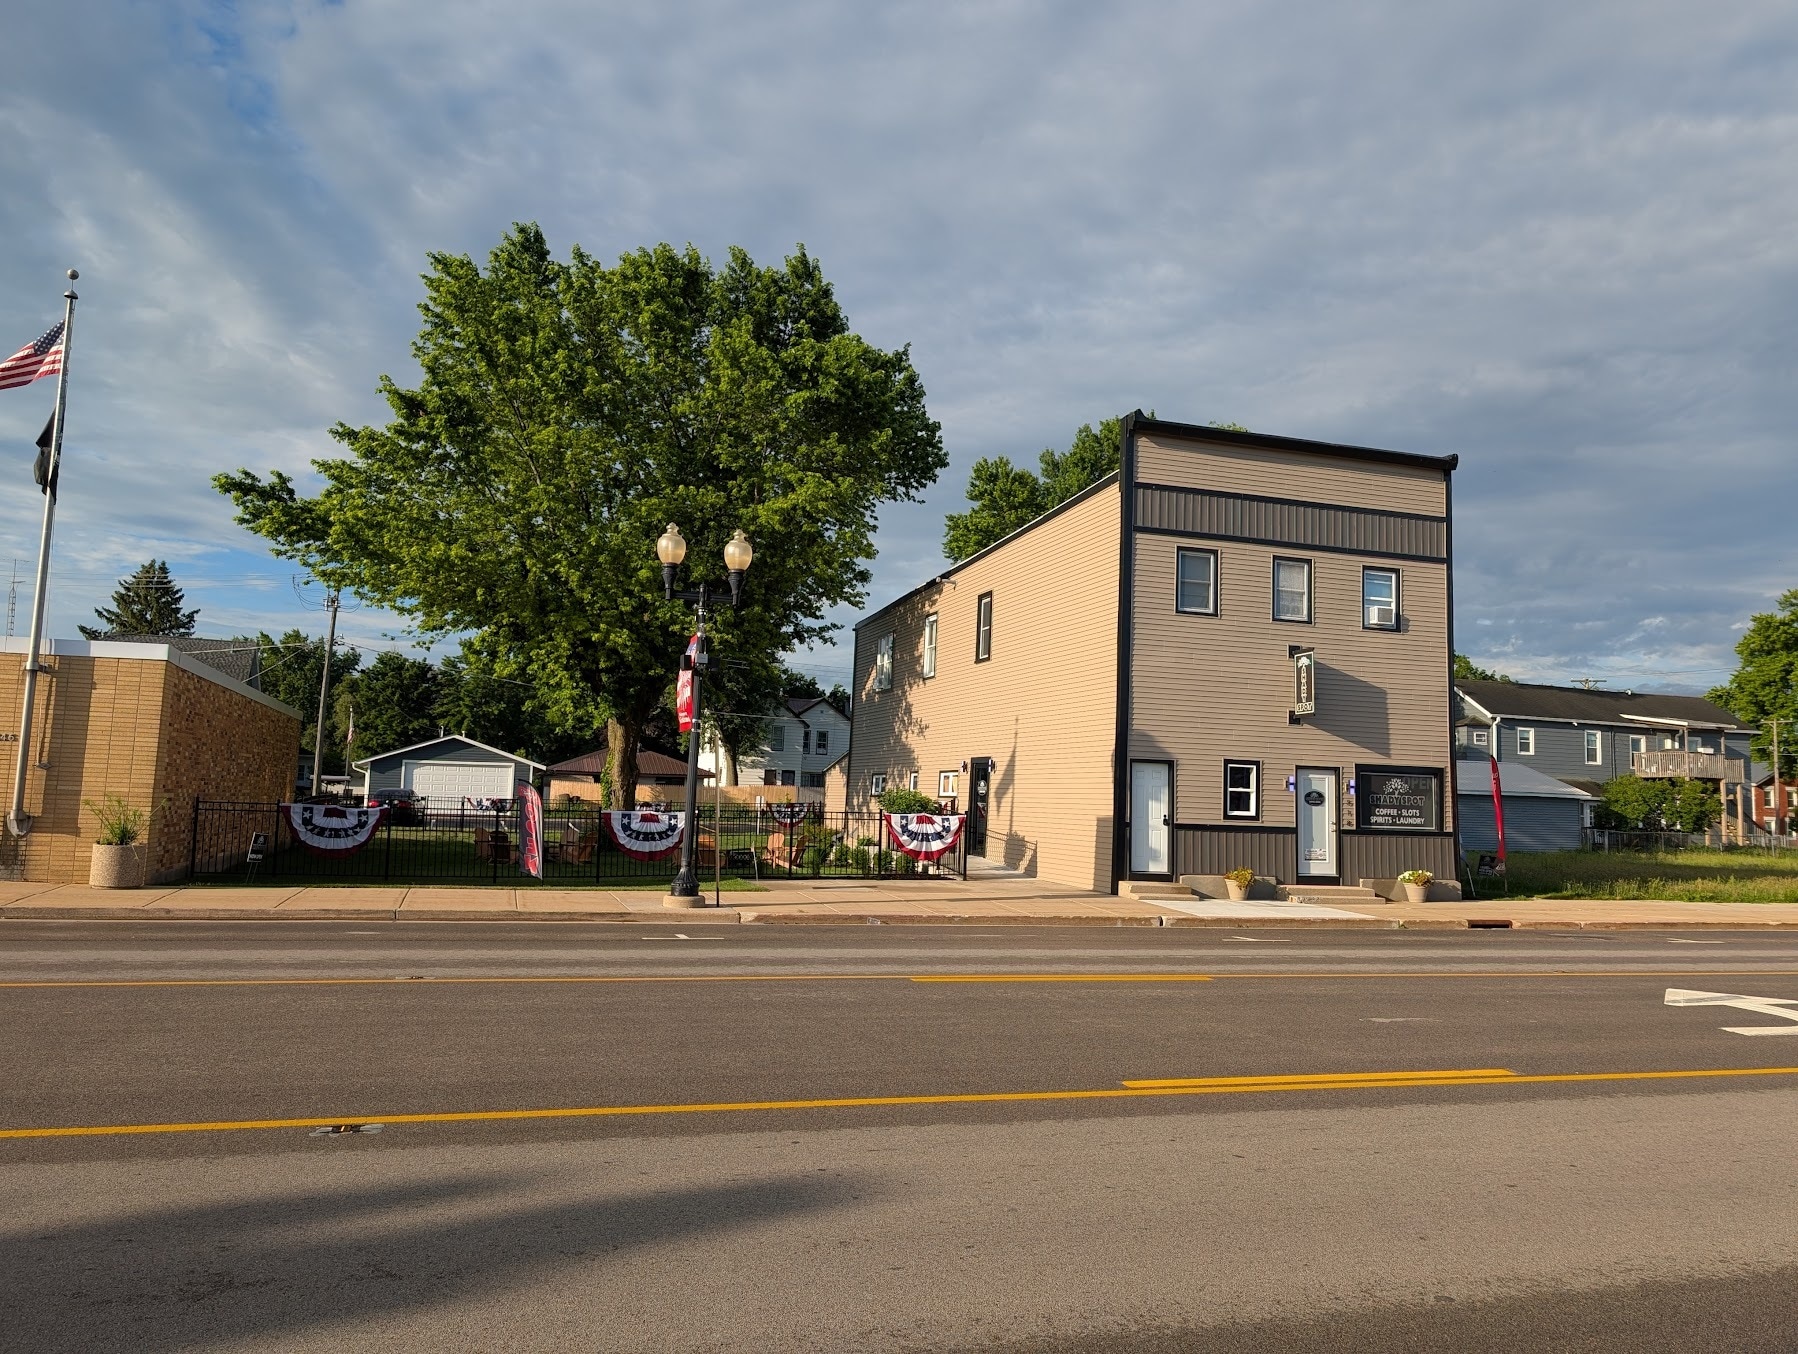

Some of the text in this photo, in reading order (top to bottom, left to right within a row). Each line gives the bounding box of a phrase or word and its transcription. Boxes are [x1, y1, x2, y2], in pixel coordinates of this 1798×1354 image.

[1297, 702, 1312, 712] SPOT
[1369, 794, 1425, 806] SHADY SPOT
[1375, 808, 1420, 817] COFFEE SLOTS
[1370, 816, 1425, 825] SPIRITS LAUNDRY
